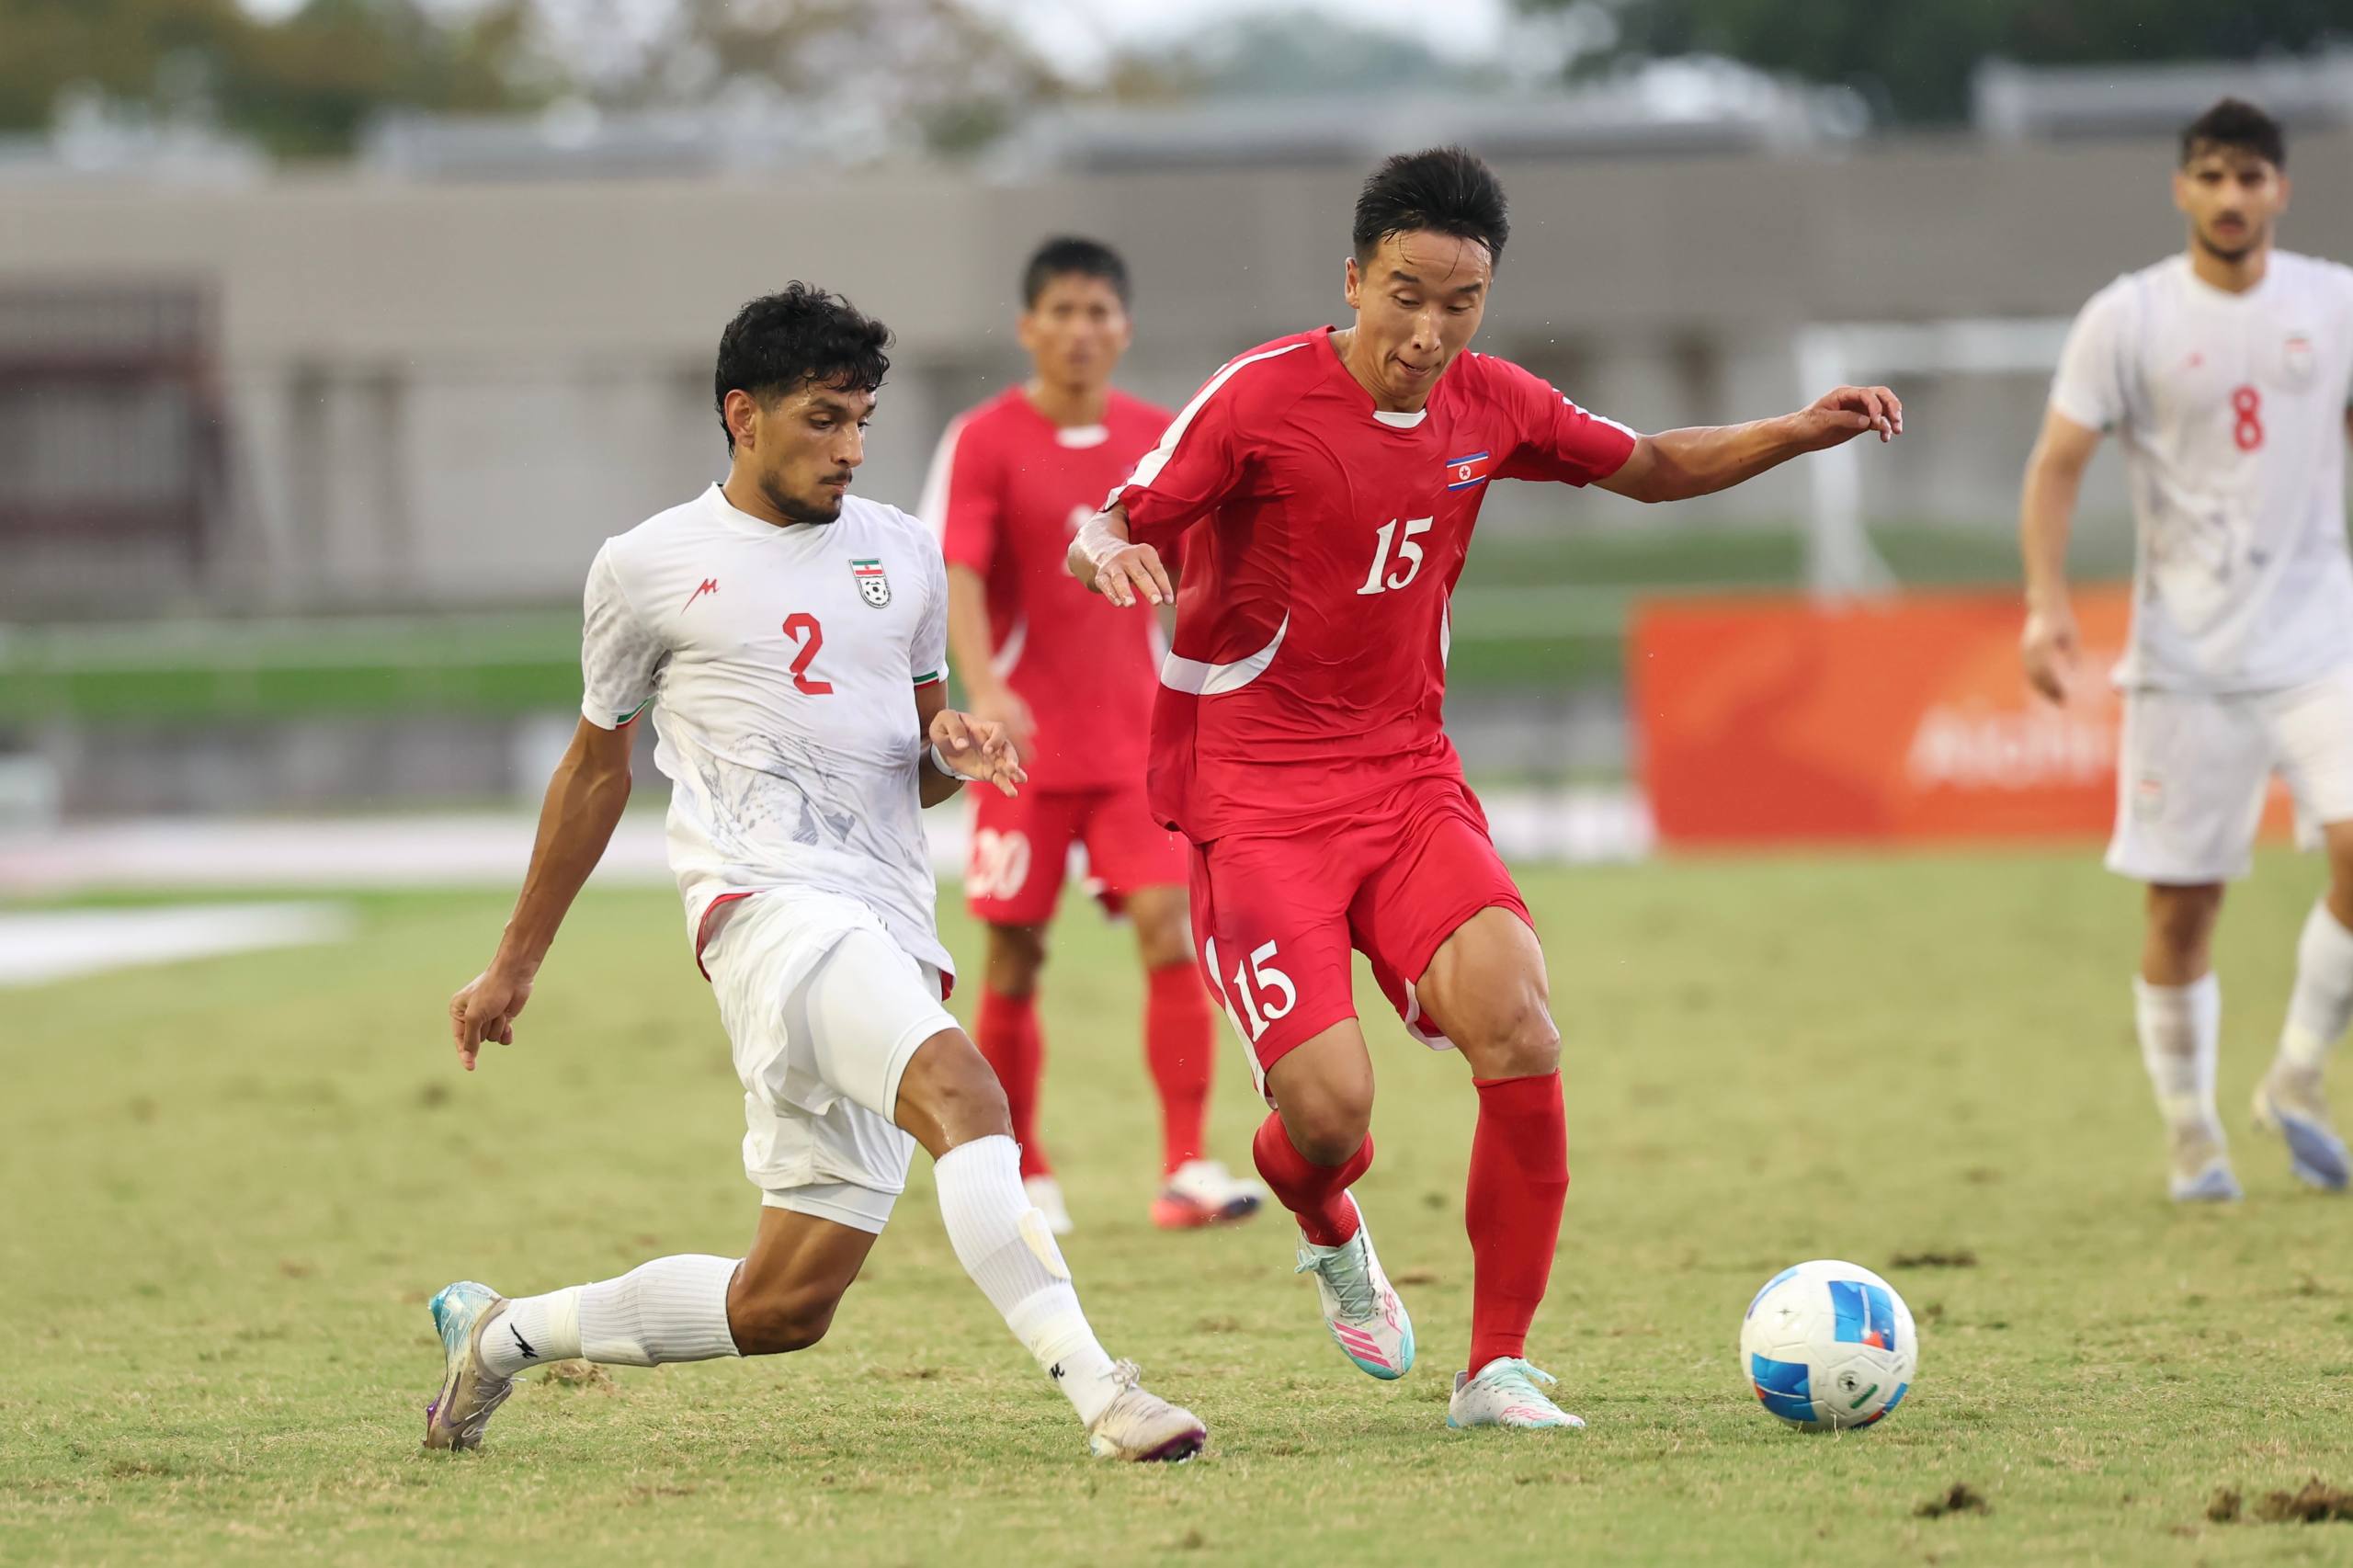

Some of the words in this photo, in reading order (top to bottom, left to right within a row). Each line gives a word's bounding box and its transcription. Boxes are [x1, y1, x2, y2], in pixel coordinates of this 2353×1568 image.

[2232, 385, 2265, 452] 8
[1357, 516, 1434, 595] 15
[783, 613, 834, 695] 2
[1233, 939, 1297, 1042] 15
